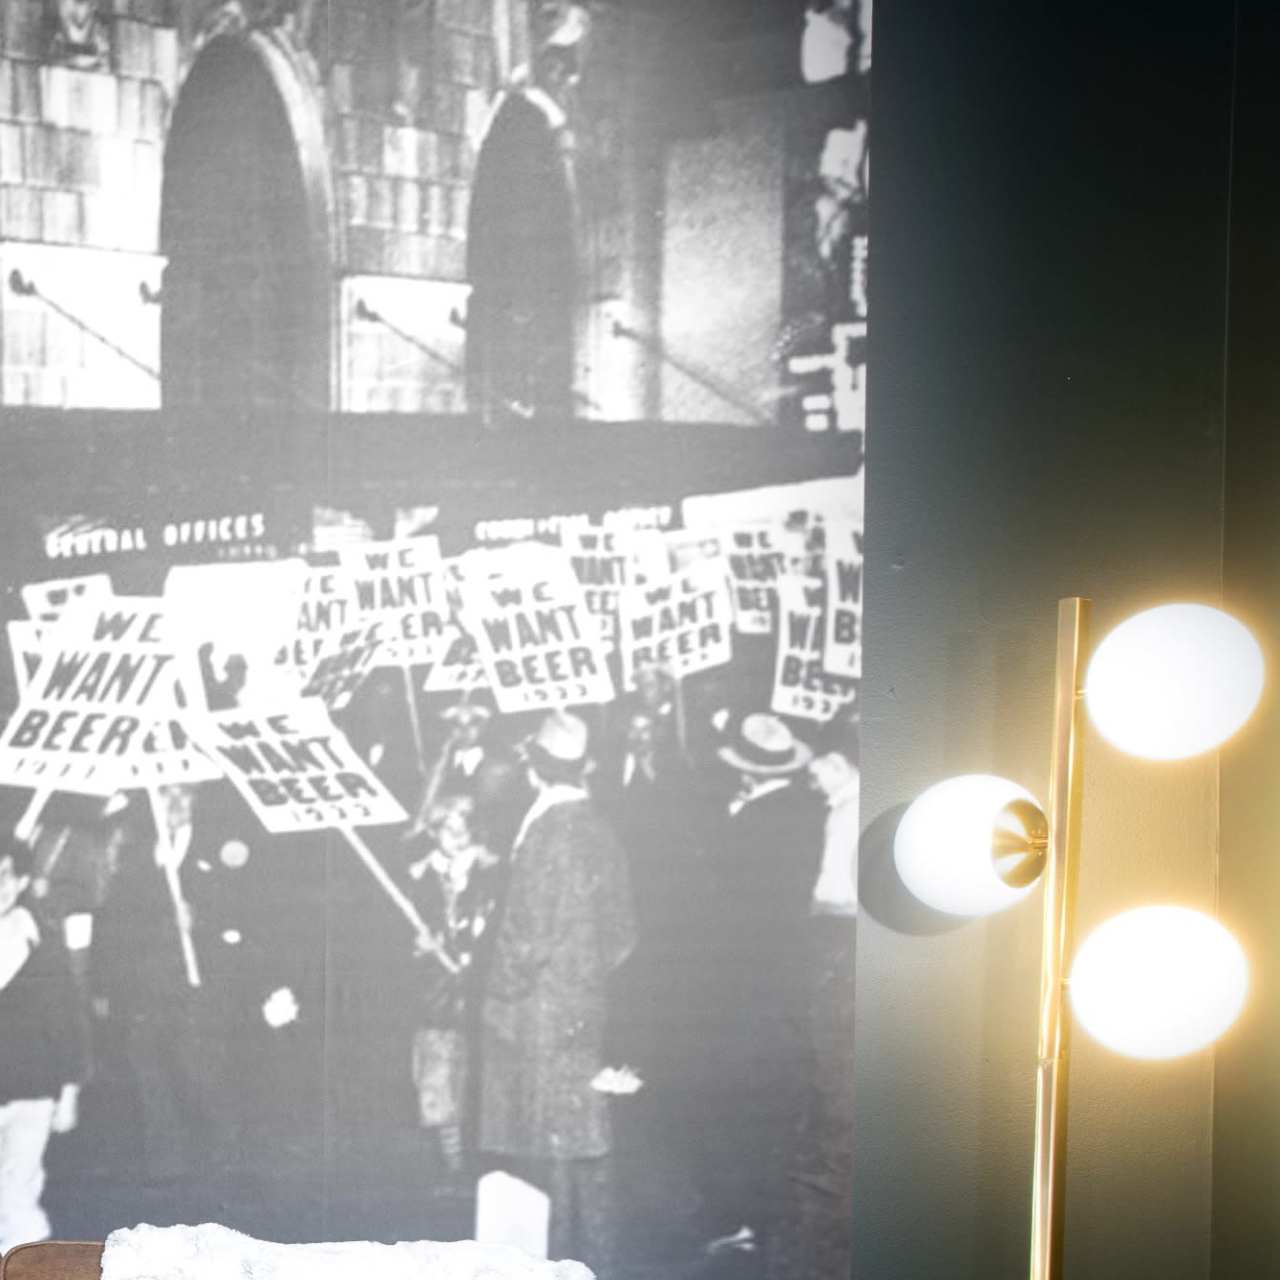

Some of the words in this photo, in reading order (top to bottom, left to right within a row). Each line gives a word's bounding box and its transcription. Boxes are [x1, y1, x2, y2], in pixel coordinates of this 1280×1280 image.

[163, 513, 265, 546] OFFICES
[366, 548, 414, 570] WE
[355, 572, 432, 610] WANT
[491, 581, 554, 608] WE
[94, 611, 163, 643] WE
[481, 603, 585, 652] WANT
[631, 591, 716, 640] WANT
[42, 651, 173, 705] WANT
[493, 646, 599, 690] BEER
[8, 708, 140, 755] BEER
[218, 714, 298, 740] WE
[217, 737, 345, 774] WANT
[248, 772, 377, 806] BEER
